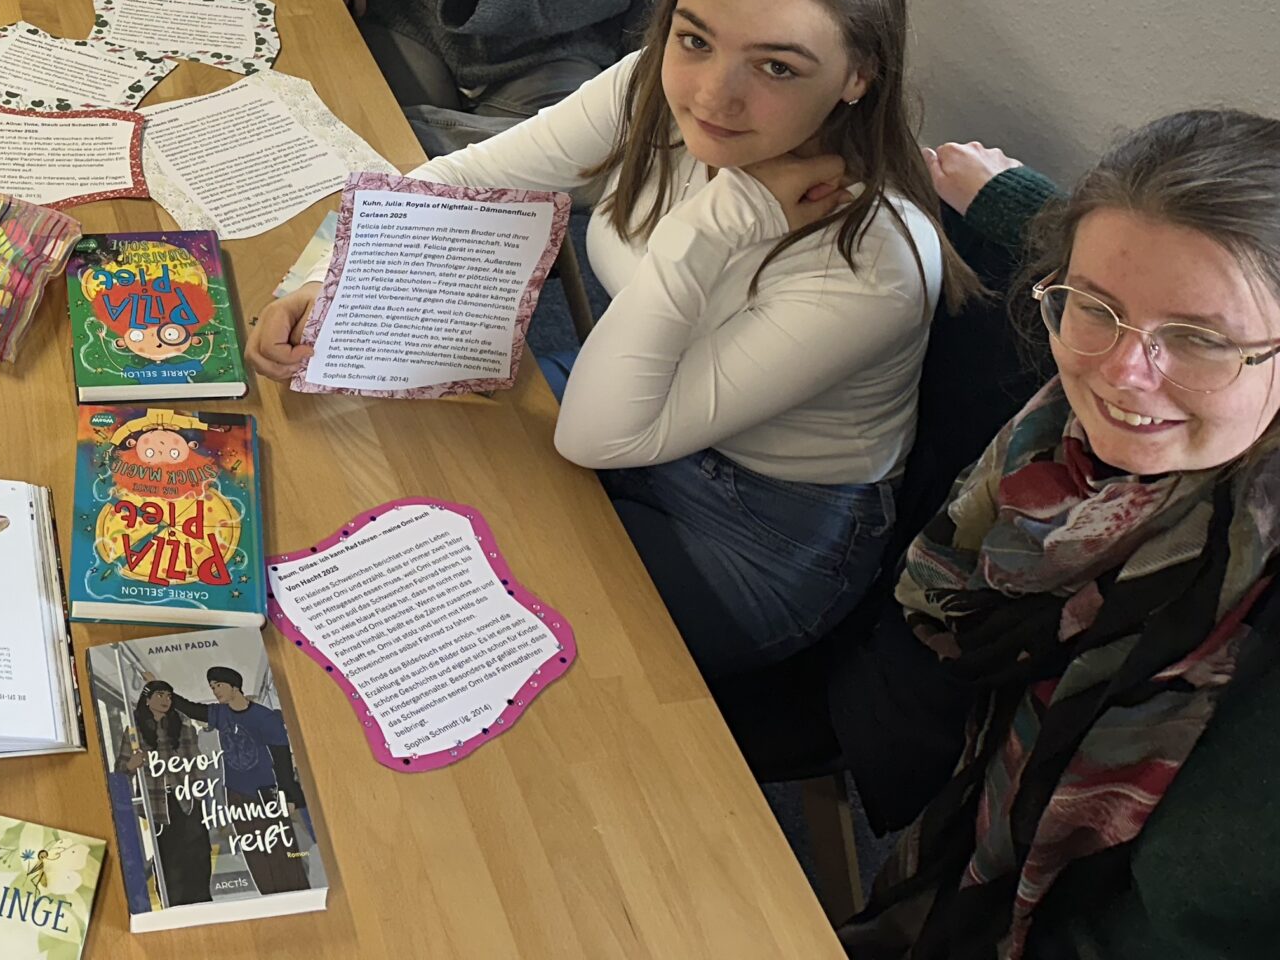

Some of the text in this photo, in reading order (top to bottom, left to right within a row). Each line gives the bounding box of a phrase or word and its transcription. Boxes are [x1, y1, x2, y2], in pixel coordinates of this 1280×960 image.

[406, 201, 431, 209] Royals
[441, 203, 473, 211] Nightfall
[480, 206, 537, 218] Dämonenfluch
[121, 248, 191, 267] QUATSCH
[92, 264, 172, 294] Piet
[120, 369, 197, 378] CARRIE SELLON
[112, 460, 217, 485] STÜCK MAGIE
[114, 500, 205, 540] Piet
[278, 570, 299, 581] Baum,
[319, 555, 330, 564] Ich
[329, 549, 346, 559] kann
[345, 543, 358, 551] Rad
[358, 534, 378, 547] fahren
[382, 524, 401, 535] meine
[401, 517, 415, 527] Omi
[414, 511, 430, 521] auch
[285, 565, 340, 592] Von Hacht 2025
[294, 531, 450, 604] Ein kleines Schweinchen berichtet von dem Leben
[121, 586, 208, 600] CARRIE SELLON
[147, 640, 219, 655] AMANI PADDA
[404, 734, 431, 751] Sophia
[429, 720, 460, 738] Schmidt
[471, 703, 493, 719] 2014)
[148, 748, 224, 777] Bevor
[175, 777, 220, 801] der
[202, 790, 289, 830] Himmel
[229, 822, 293, 856] reißt
